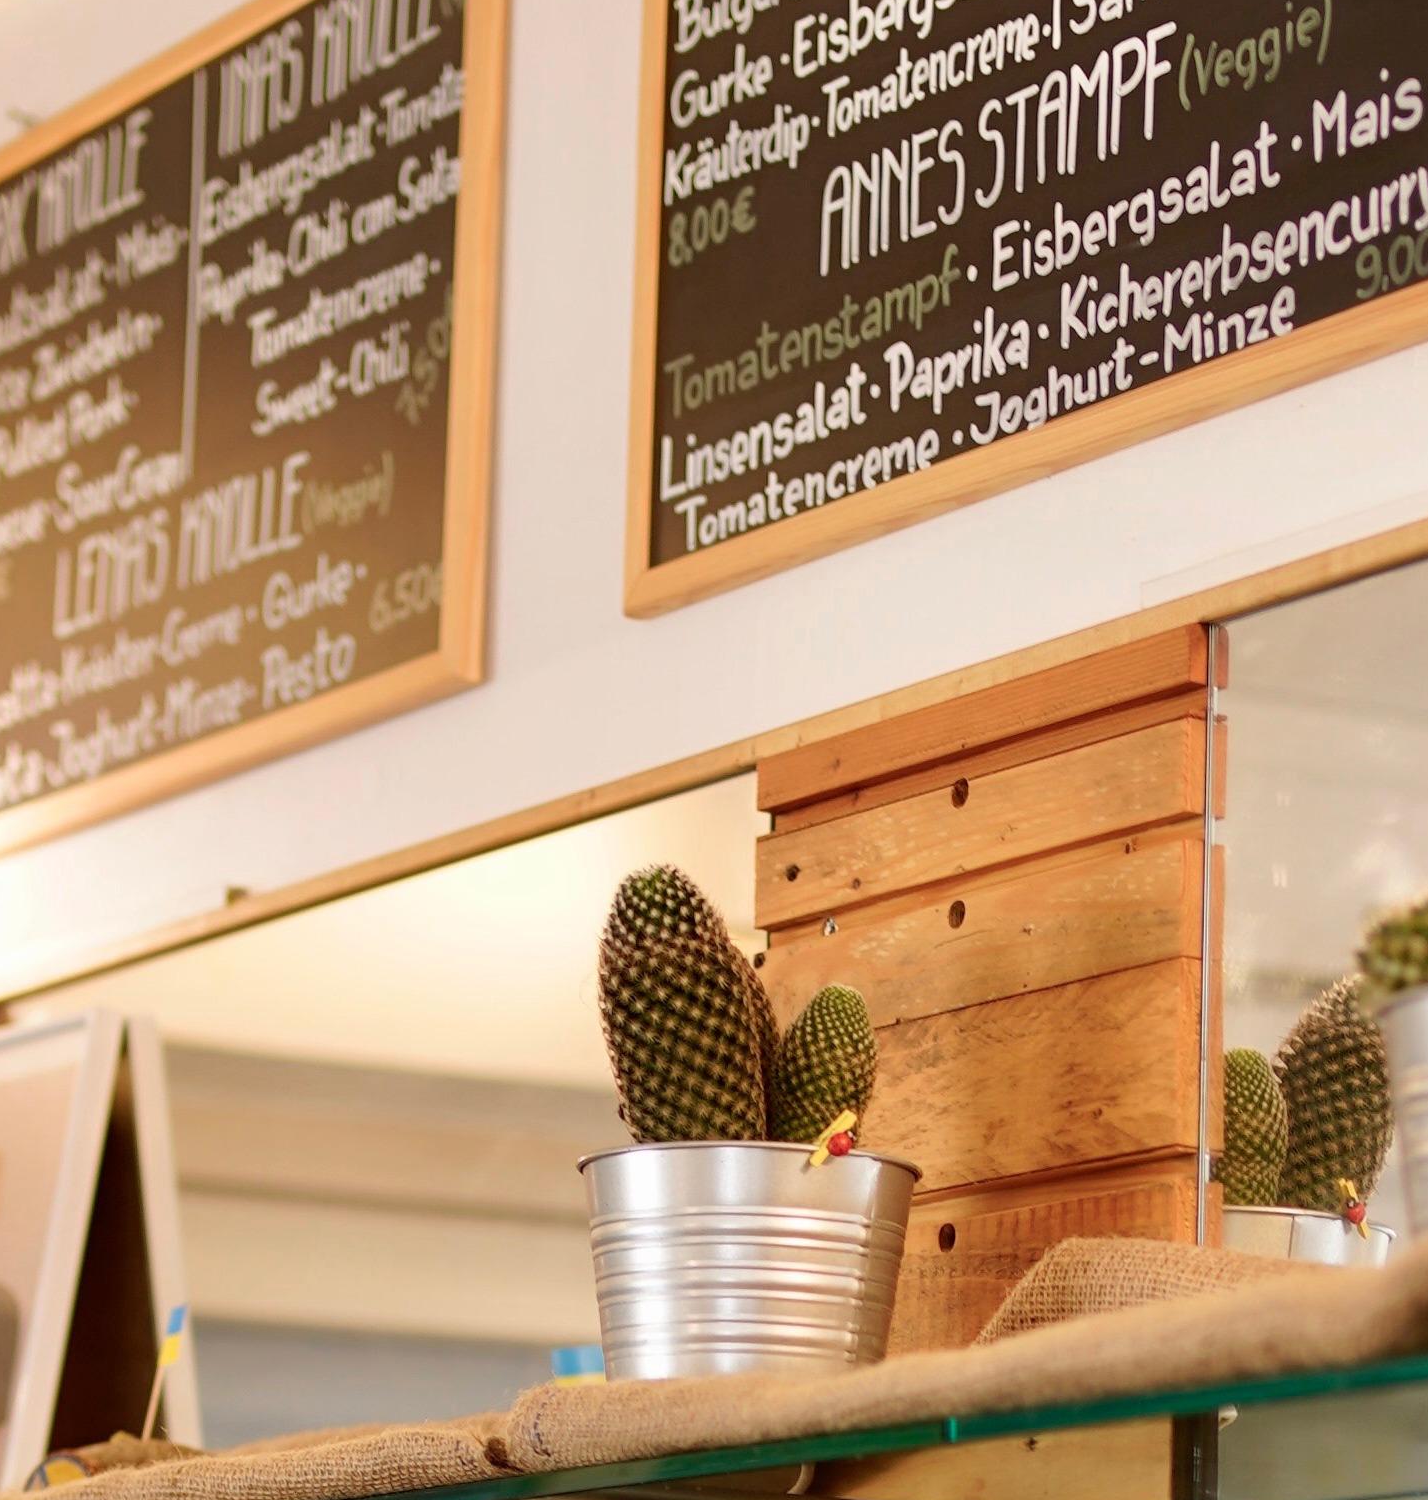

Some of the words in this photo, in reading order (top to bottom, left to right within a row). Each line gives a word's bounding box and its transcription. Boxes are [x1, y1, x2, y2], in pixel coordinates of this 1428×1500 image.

[218, 19, 304, 159] INAS
[663, 104, 810, 207] Kräuterdip
[821, 12, 1038, 138] Tomatencreme
[671, 43, 773, 128] Gurke
[820, 119, 965, 277] ANNES
[976, 21, 1177, 209] STAMPF
[36, 107, 153, 256] KNOLLE
[200, 103, 377, 247] Eisbergsalat
[287, 197, 350, 277] Chili
[665, 243, 960, 419] Tomatenstampf
[992, 120, 1281, 291] Eisbergsalat
[1312, 68, 1424, 163] Mais
[247, 252, 428, 369] Tomatencreme
[660, 363, 869, 502] Linsensalat
[884, 306, 1030, 415] Paprika
[177, 450, 311, 591] KNOLLE
[674, 428, 939, 552] Tomatencreme
[263, 551, 354, 631] Gurke
[260, 628, 358, 709] Pesto
